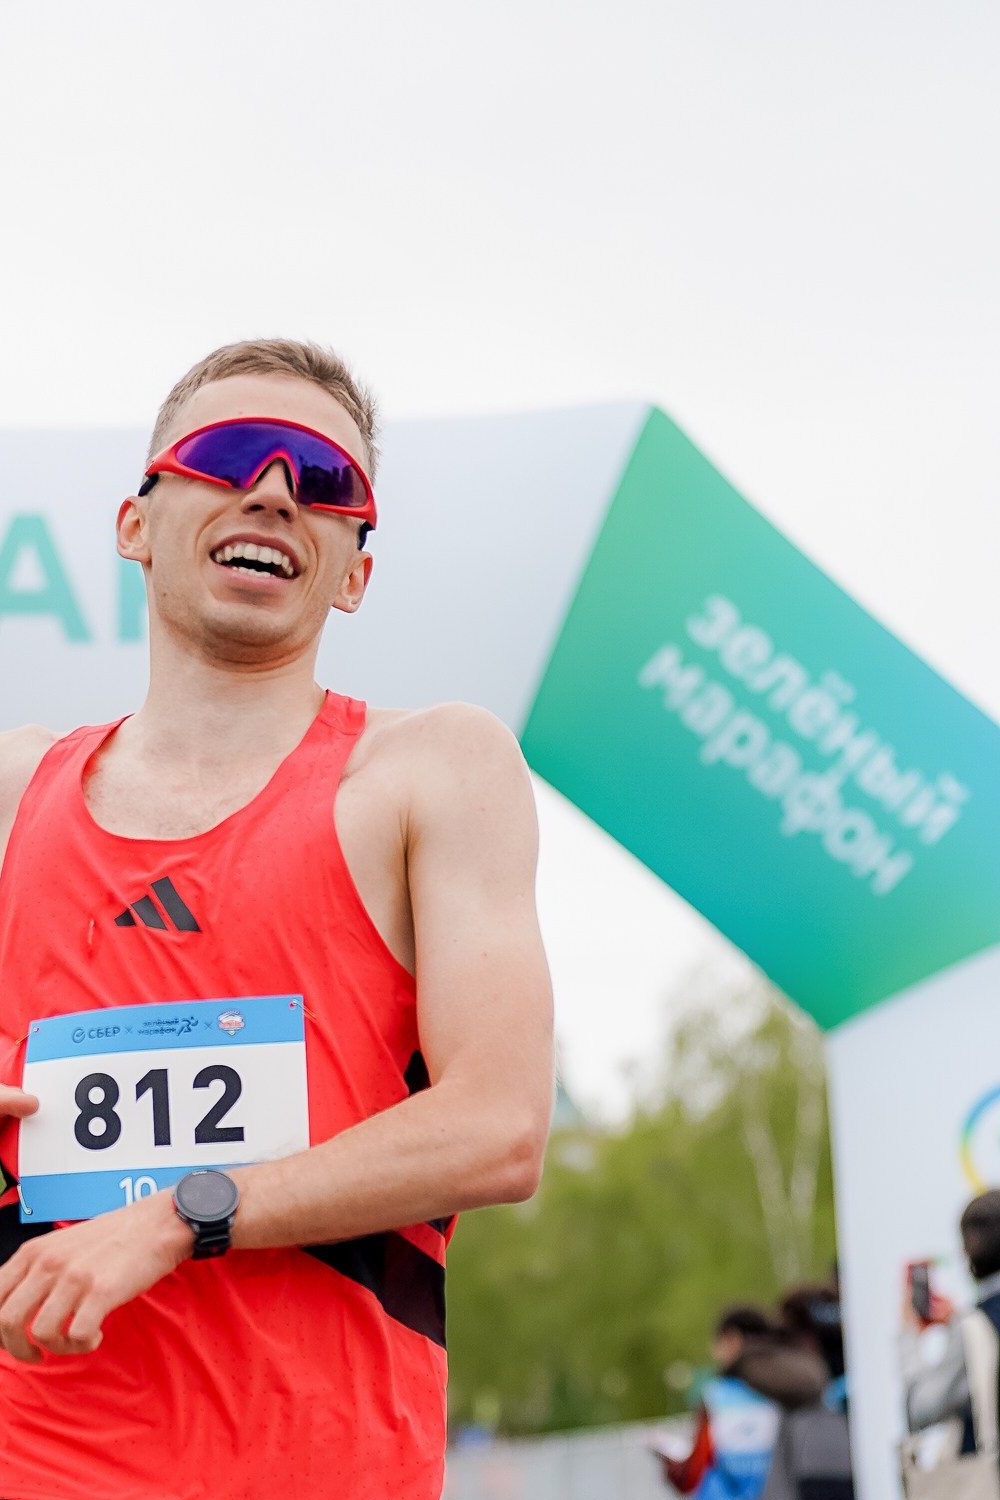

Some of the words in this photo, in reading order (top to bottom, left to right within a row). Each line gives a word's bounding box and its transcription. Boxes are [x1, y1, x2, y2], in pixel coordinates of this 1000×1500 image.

[685, 594, 970, 846] зелёный
[638, 643, 915, 897] марафон
[88, 1026, 120, 1039] СБЕР
[74, 1064, 244, 1150] 812
[119, 1176, 158, 1206] 10
